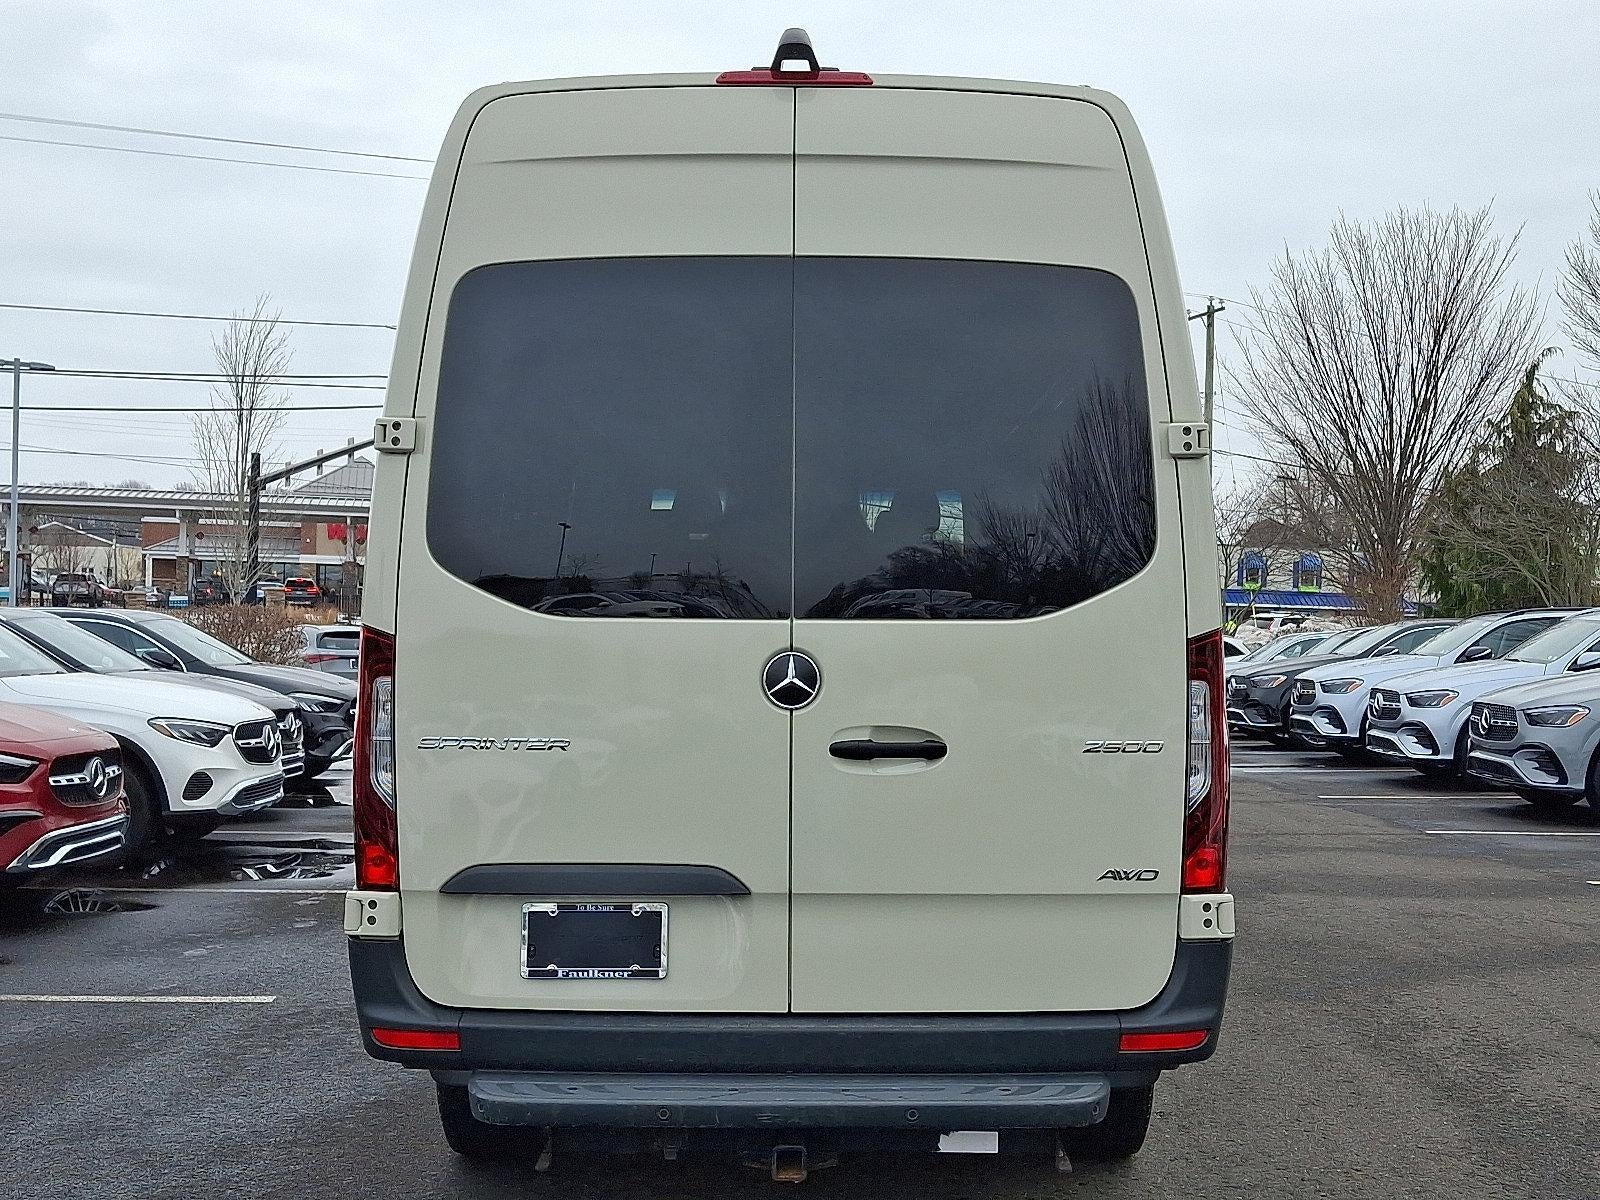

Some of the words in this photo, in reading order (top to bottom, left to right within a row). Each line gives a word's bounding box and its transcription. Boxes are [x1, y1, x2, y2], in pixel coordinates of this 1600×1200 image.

[417, 736, 570, 751] SPRINTER
[1082, 740, 1165, 754] 2500
[1096, 868, 1160, 881] AWD
[557, 969, 632, 978] Faulkner
